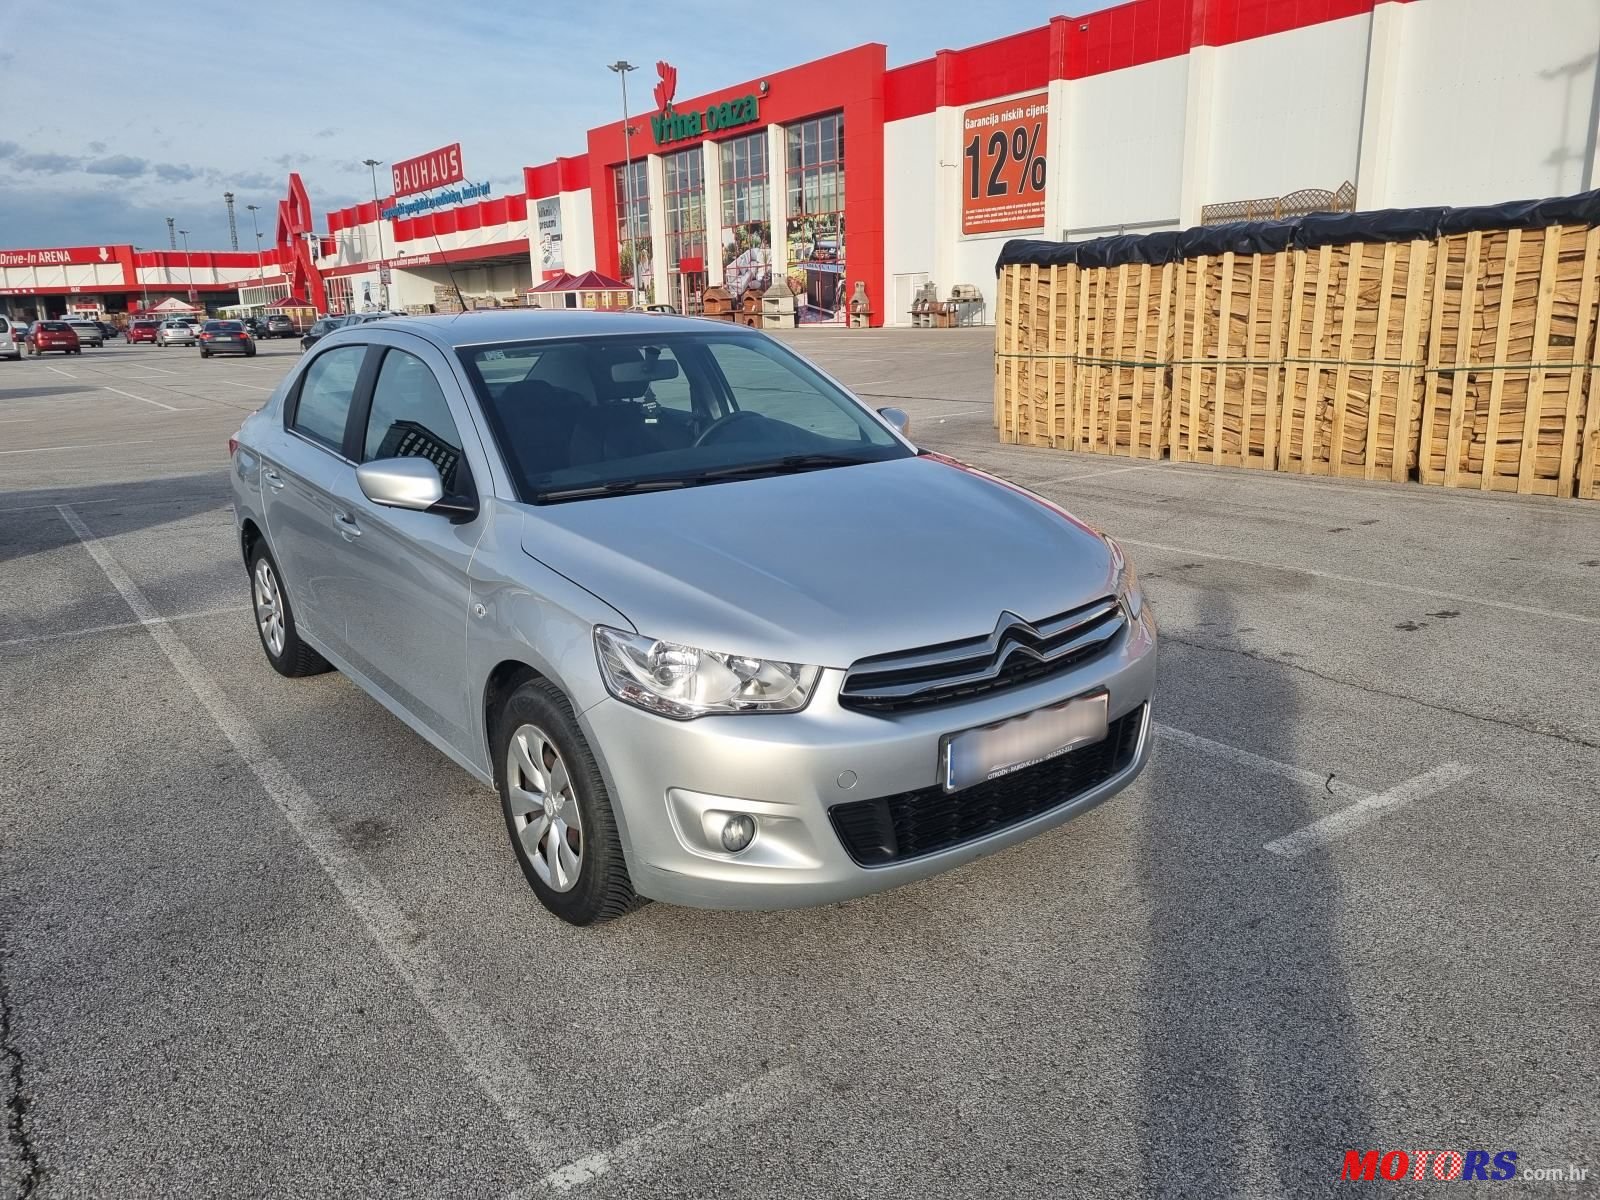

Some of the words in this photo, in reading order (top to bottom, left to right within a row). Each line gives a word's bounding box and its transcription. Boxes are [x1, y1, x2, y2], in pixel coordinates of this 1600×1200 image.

[650, 111, 702, 144] Vrtna
[706, 95, 759, 132] oaza
[965, 114, 999, 129] Garancija
[1001, 108, 1024, 122] niskih
[1026, 103, 1049, 119] cijena
[393, 150, 459, 192] BAUHAUS
[965, 122, 1047, 200] 12%
[0, 252, 36, 265] Drive-In
[38, 250, 71, 263] ARENA
